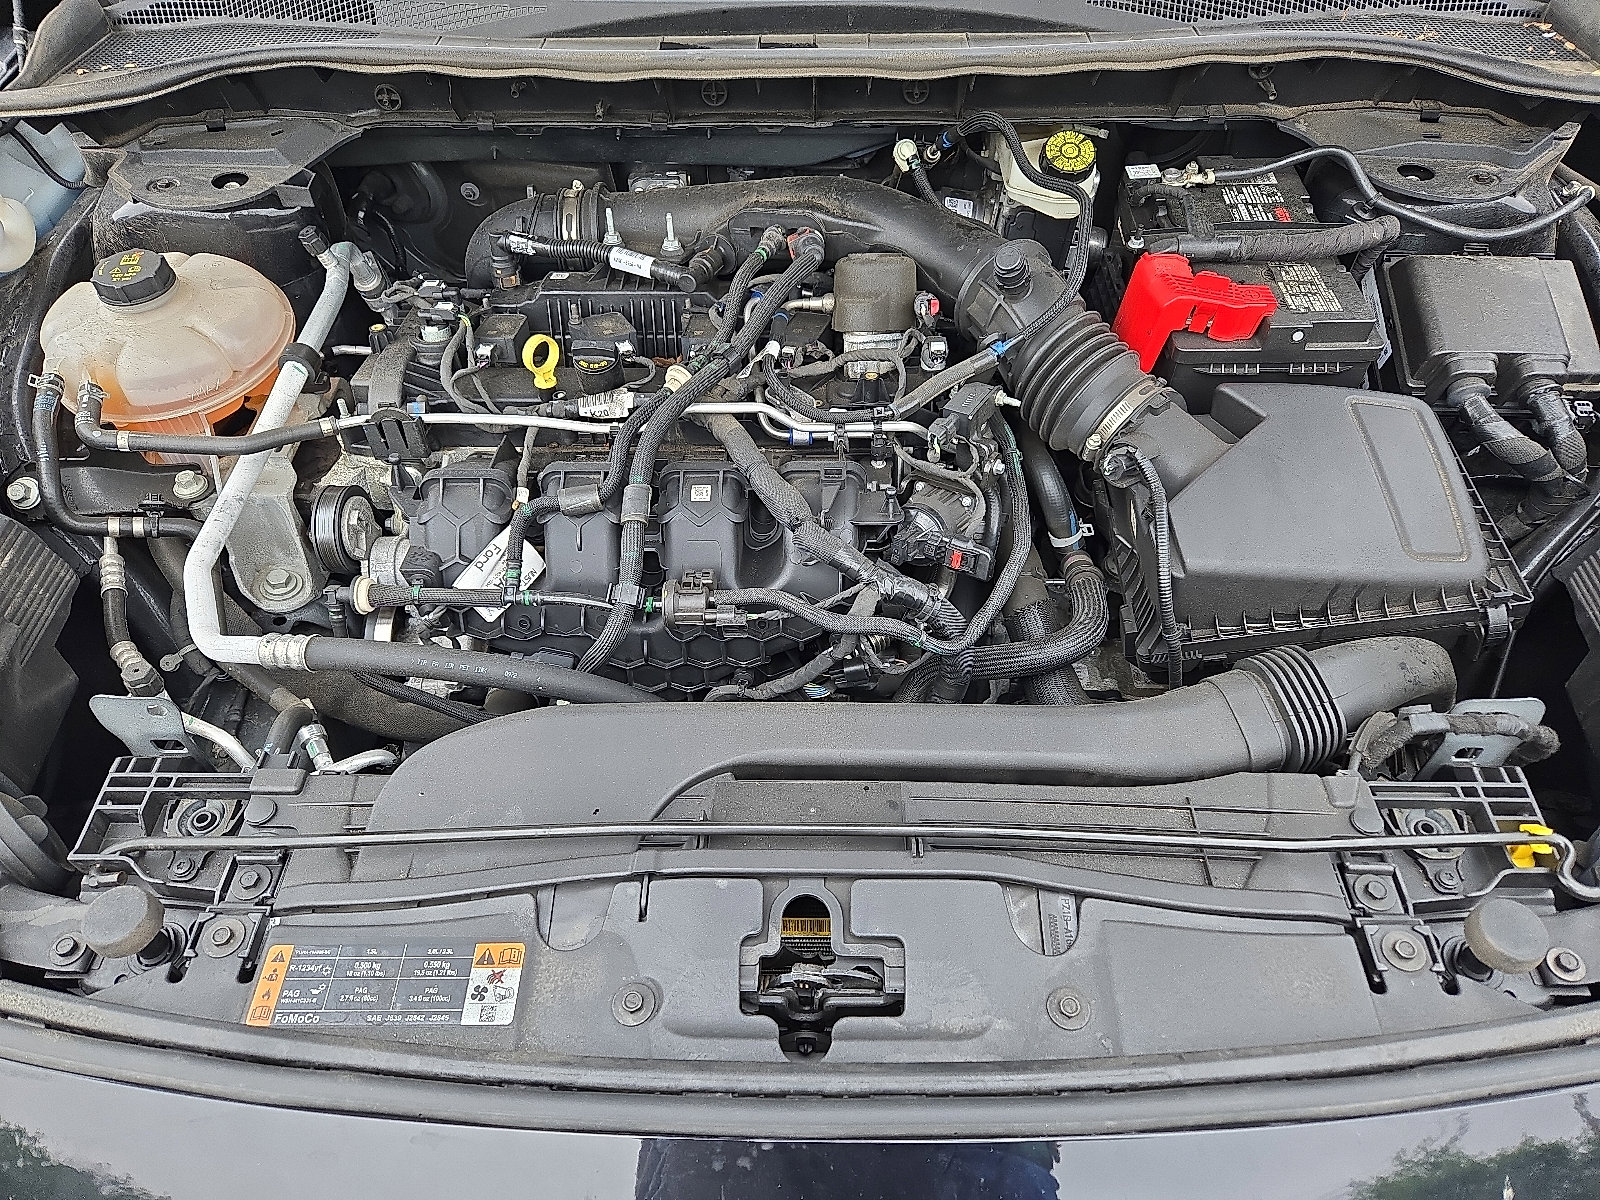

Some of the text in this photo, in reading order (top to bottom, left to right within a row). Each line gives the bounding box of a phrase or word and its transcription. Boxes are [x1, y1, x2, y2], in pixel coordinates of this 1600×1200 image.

[474, 543, 502, 572] Ford
[288, 964, 323, 972] R-1234yf
[282, 989, 301, 998] PAG
[354, 986, 368, 994] PAG
[274, 1013, 320, 1024] FoMoCo
[366, 1014, 383, 1022] SAE
